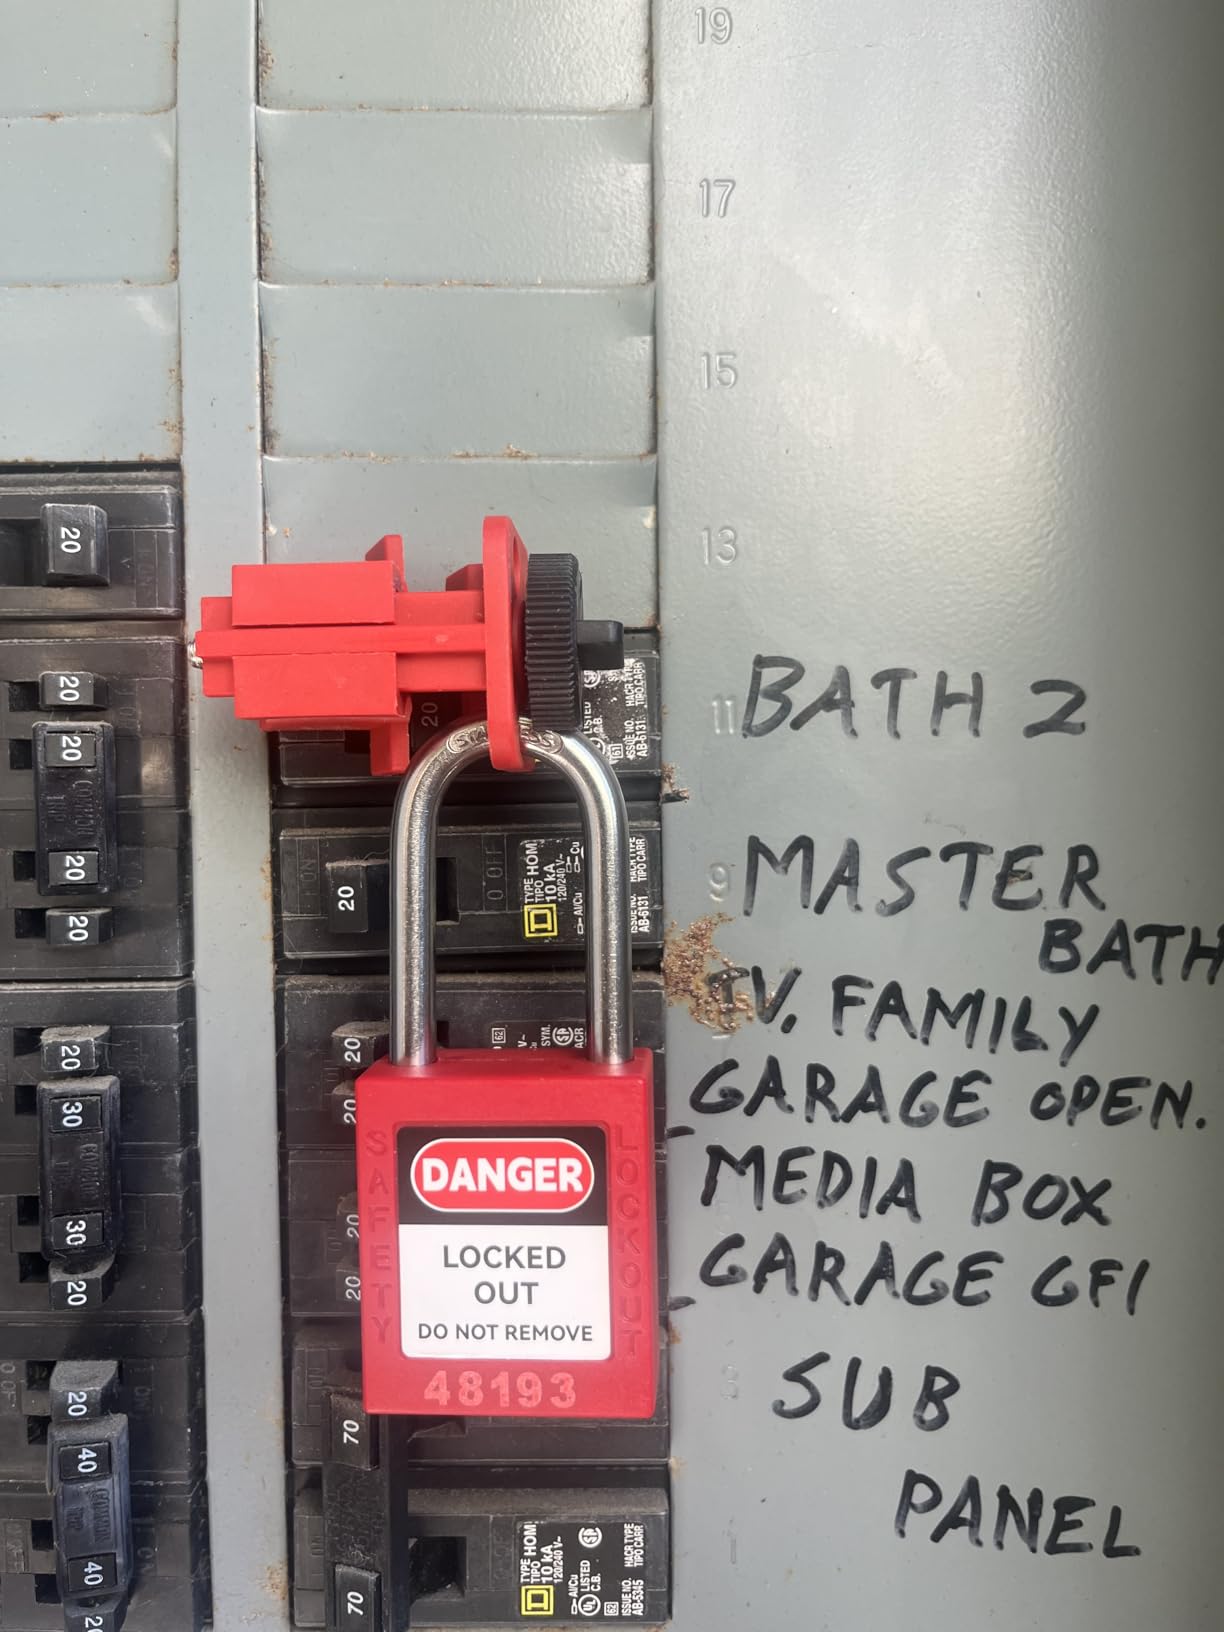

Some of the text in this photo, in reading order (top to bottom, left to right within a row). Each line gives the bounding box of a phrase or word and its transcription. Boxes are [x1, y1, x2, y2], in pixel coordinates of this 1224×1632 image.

[695, 7, 733, 45] 19
[699, 178, 737, 218] 17
[700, 352, 739, 391] 15
[61, 526, 81, 554] 20
[701, 528, 739, 567] 13
[59, 676, 80, 703] 20
[742, 654, 1087, 740] BATH 2
[420, 702, 439, 727] 20
[711, 696, 736, 735] 11
[62, 735, 82, 763] 20
[570, 841, 580, 854] Cu
[635, 838, 647, 883] TIPO CARR
[65, 854, 85, 882] 20
[524, 842, 539, 903] TYPE HOM
[543, 863, 557, 902] 10 kA
[709, 862, 730, 902] 9
[743, 835, 1107, 917] MASTER
[338, 885, 355, 911] 20
[534, 880, 544, 903] TIPO
[557, 868, 567, 901] 120/240
[638, 895, 650, 933] AB-6131
[68, 915, 89, 943] 20
[1039, 918, 1224, 985] BATH
[832, 975, 1100, 1066] FAMILY
[344, 1037, 361, 1063] 20
[574, 1027, 584, 1049] ACR
[60, 1043, 81, 1072] 20
[689, 1055, 1207, 1130] GARAGE OPEN.
[61, 1100, 83, 1128] 30
[343, 1099, 356, 1124] 20
[421, 1157, 584, 1193] DANGER
[700, 1144, 1112, 1227] MEDIA BOX
[65, 1219, 87, 1246] 30
[346, 1213, 360, 1238] 20
[443, 1245, 566, 1269] LOCKED
[345, 1275, 361, 1301] 20
[699, 1232, 1151, 1315] GARAGE GFI
[66, 1279, 87, 1308] 20
[474, 1281, 539, 1305] OUT
[418, 1323, 593, 1342] DO NOT REMOVE
[423, 1370, 576, 1408] 48193
[772, 1351, 960, 1431] SUB
[67, 1391, 88, 1418] 20
[343, 1419, 360, 1445] 70
[76, 1446, 97, 1474] 40
[894, 1468, 1141, 1559] PANEL
[520, 1523, 537, 1583] TYPE HOM
[624, 1523, 634, 1567] HACR TYPE
[634, 1548, 644, 1567] TIPO
[83, 1559, 104, 1587] 40
[530, 1560, 541, 1584] TIPO
[541, 1544, 554, 1583] 10 kA
[553, 1549, 564, 1583] 120/240
[580, 1560, 591, 1591] LISTED
[591, 1573, 601, 1591] C.B.
[347, 1590, 364, 1616] 70
[621, 1578, 632, 1616] ISSUE NO.
[632, 1579, 644, 1616] AB-5345
[85, 1616, 103, 1632] 2
